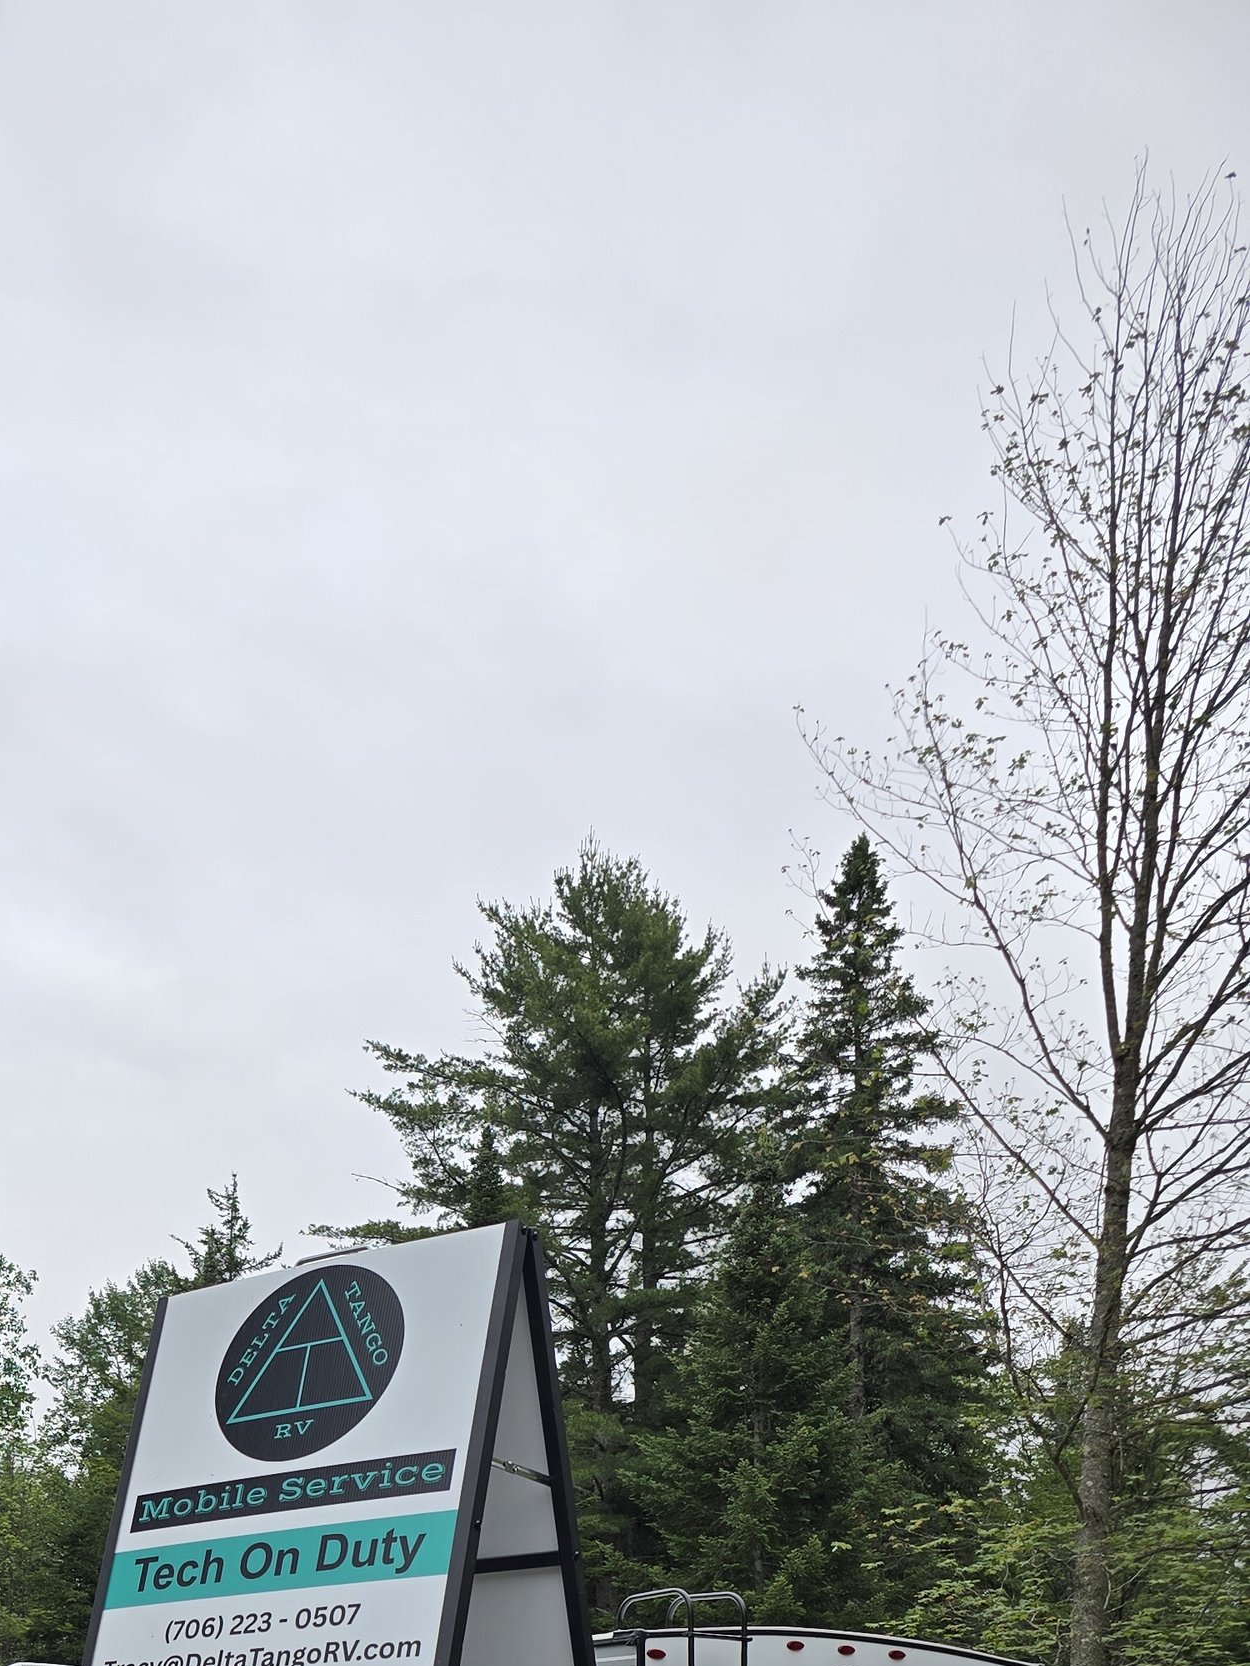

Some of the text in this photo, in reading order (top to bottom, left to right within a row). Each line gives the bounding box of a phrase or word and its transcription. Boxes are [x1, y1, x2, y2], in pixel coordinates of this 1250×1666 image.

[227, 1293, 297, 1386] DELTA
[344, 1280, 389, 1365] TANGO
[273, 1419, 314, 1439] RV
[138, 1461, 446, 1523] Mobile Service
[134, 1527, 427, 1593] Tech On Duty
[164, 1614, 224, 1644] (706)
[229, 1611, 272, 1636] 223
[294, 1602, 362, 1630] 0507
